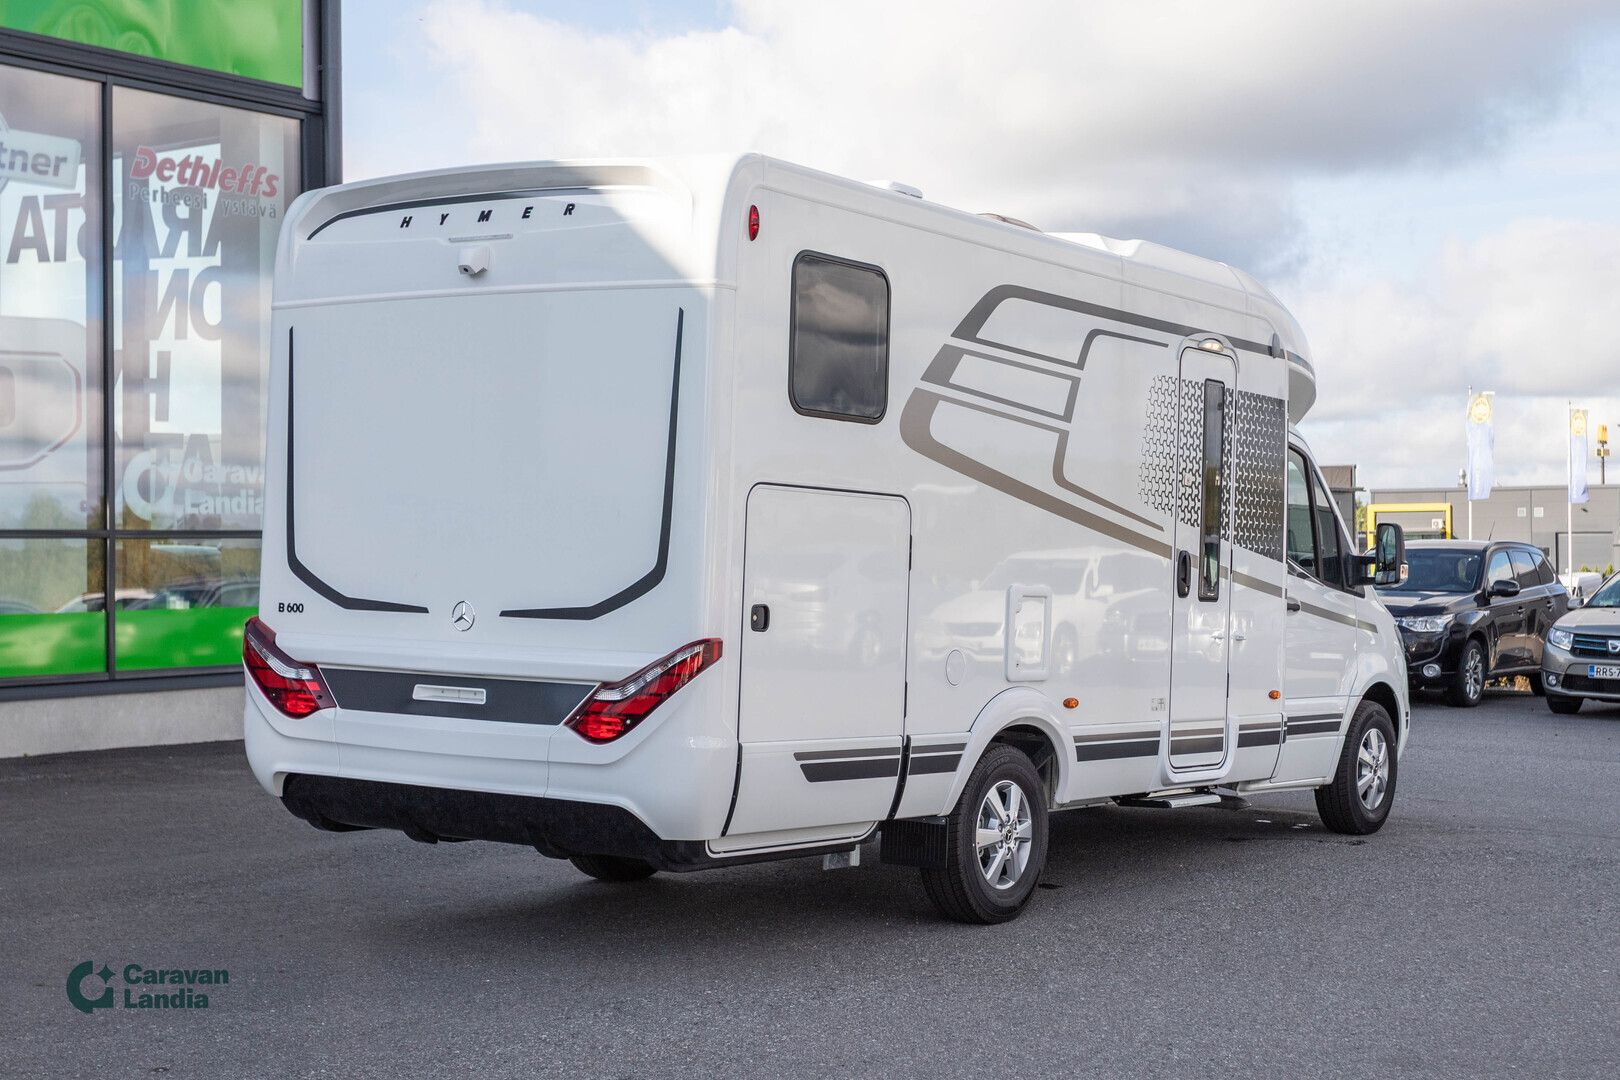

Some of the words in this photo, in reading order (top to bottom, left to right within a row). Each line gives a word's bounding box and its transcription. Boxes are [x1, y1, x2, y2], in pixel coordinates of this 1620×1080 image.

[130, 144, 280, 198] Dethleffs
[128, 182, 208, 210] Perheesi
[400, 203, 575, 228] HYMER
[278, 602, 285, 613] B
[286, 602, 305, 613] 600
